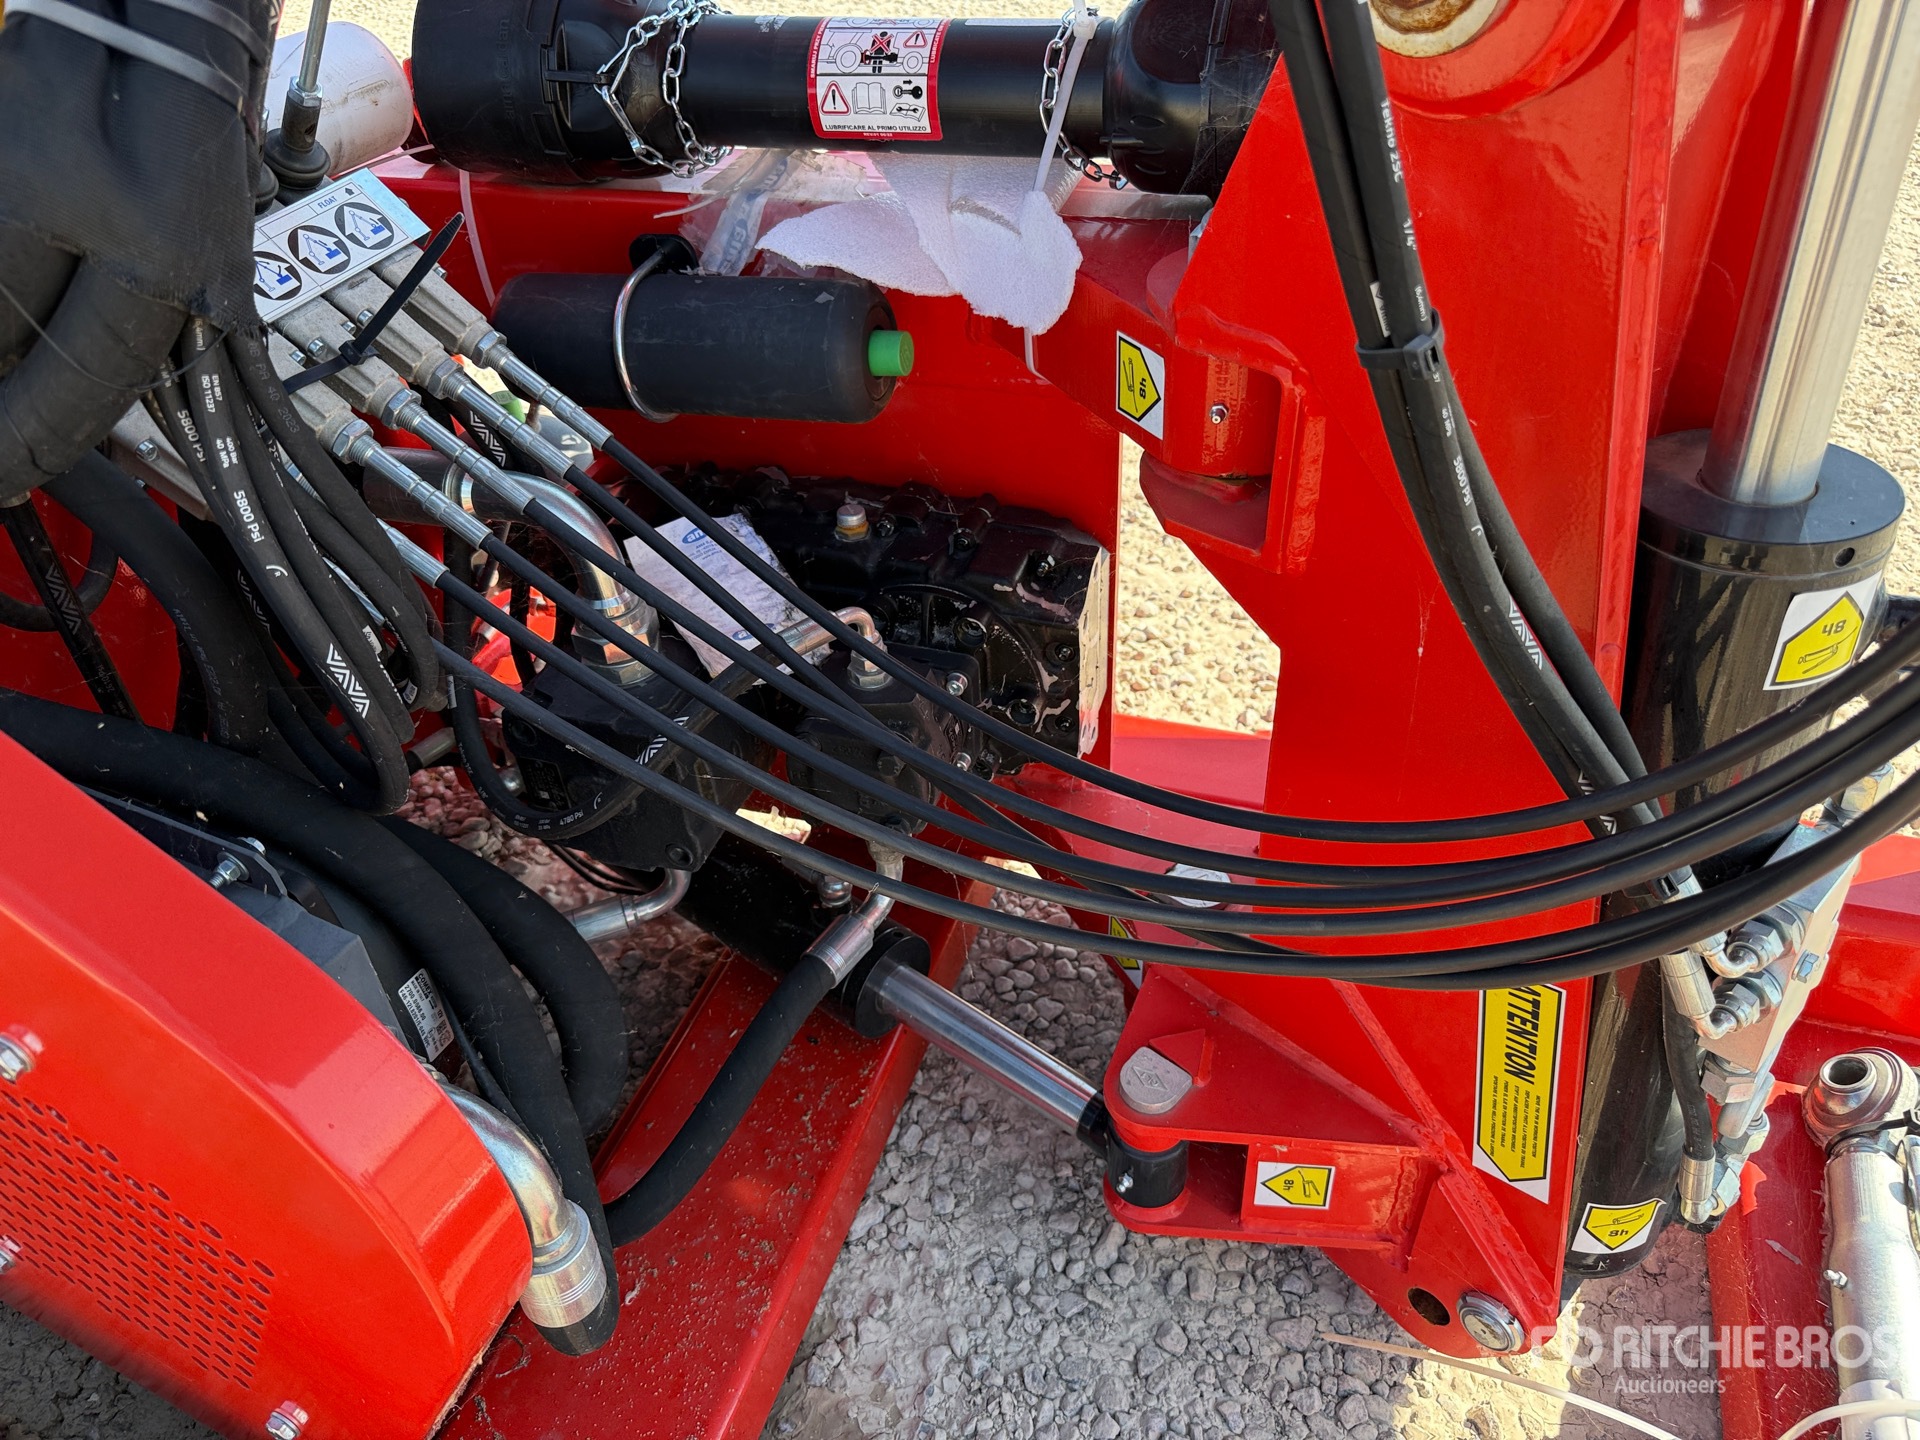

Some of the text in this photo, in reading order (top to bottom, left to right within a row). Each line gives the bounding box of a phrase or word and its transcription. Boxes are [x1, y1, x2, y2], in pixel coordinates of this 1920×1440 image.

[930, 31, 941, 63] LUBRICATE
[1389, 151, 1402, 183] 2SC
[317, 195, 338, 210] FLOAT
[201, 375, 215, 414] ISO 11237
[212, 374, 222, 401] EN 857
[177, 409, 199, 442] 5800
[277, 406, 300, 434] 2023
[1440, 407, 1450, 420] 40
[215, 438, 230, 468] 40 MPa
[225, 437, 239, 465] 400 Bar
[1452, 455, 1474, 507] 5800 Psi
[233, 489, 265, 543] 5800 Psi
[559, 815, 575, 826] 4780
[418, 973, 433, 995] COMEX
[1503, 988, 1541, 1085] ATTENTION
[1283, 1179, 1294, 1192] 8h
[1608, 1229, 1629, 1237] 8h
